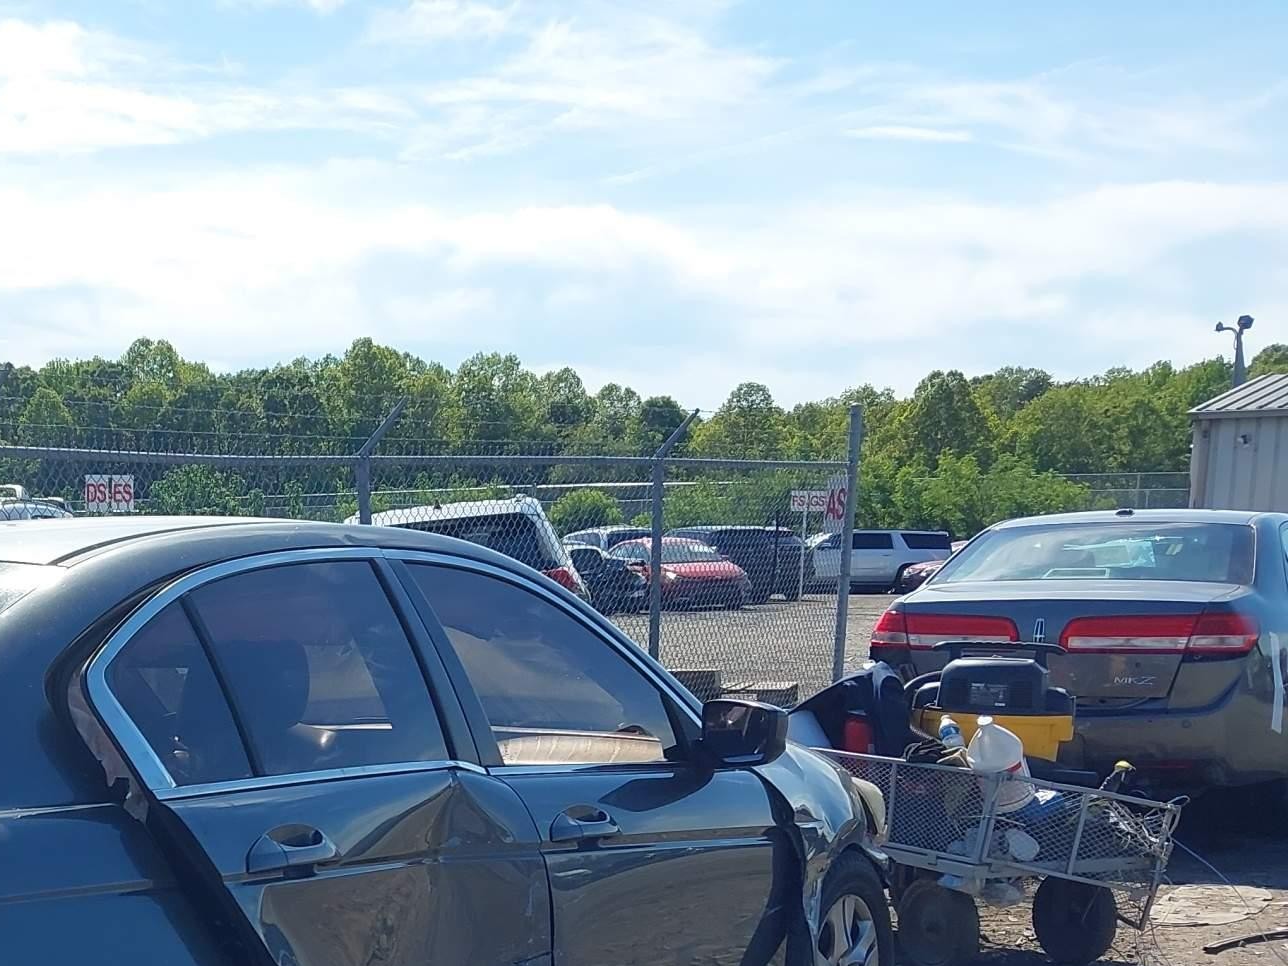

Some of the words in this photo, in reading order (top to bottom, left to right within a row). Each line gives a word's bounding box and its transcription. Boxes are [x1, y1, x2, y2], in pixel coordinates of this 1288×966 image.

[86, 483, 107, 503] DS
[113, 483, 132, 503] ES
[825, 488, 848, 520] AS
[1113, 676, 1157, 685] MKZ
